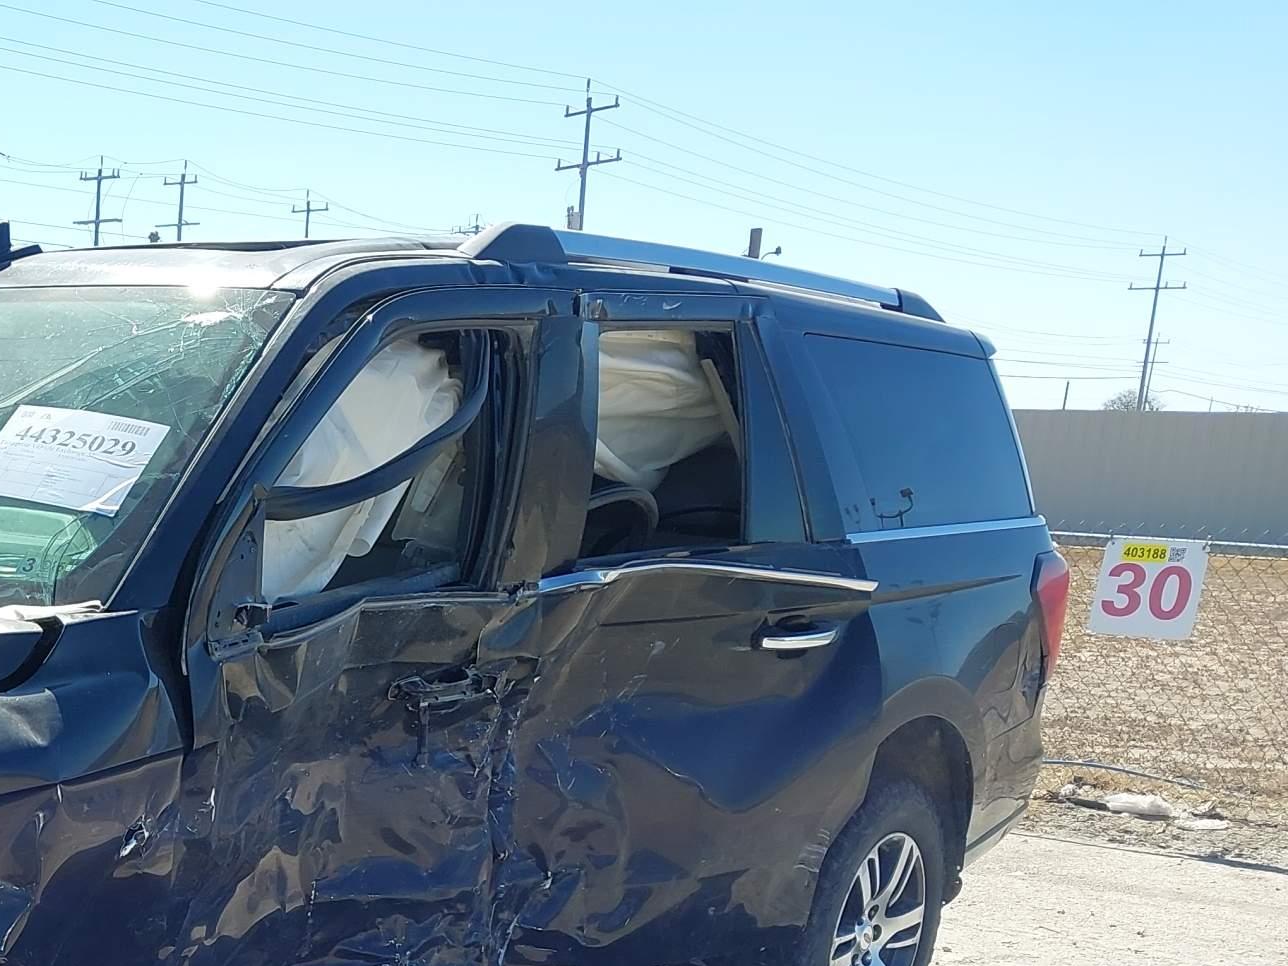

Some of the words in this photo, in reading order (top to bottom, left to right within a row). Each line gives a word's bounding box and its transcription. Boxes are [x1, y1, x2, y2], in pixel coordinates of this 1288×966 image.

[15, 425, 137, 457] 44325029
[1123, 546, 1167, 560] 403188
[1101, 562, 1192, 621] 30
